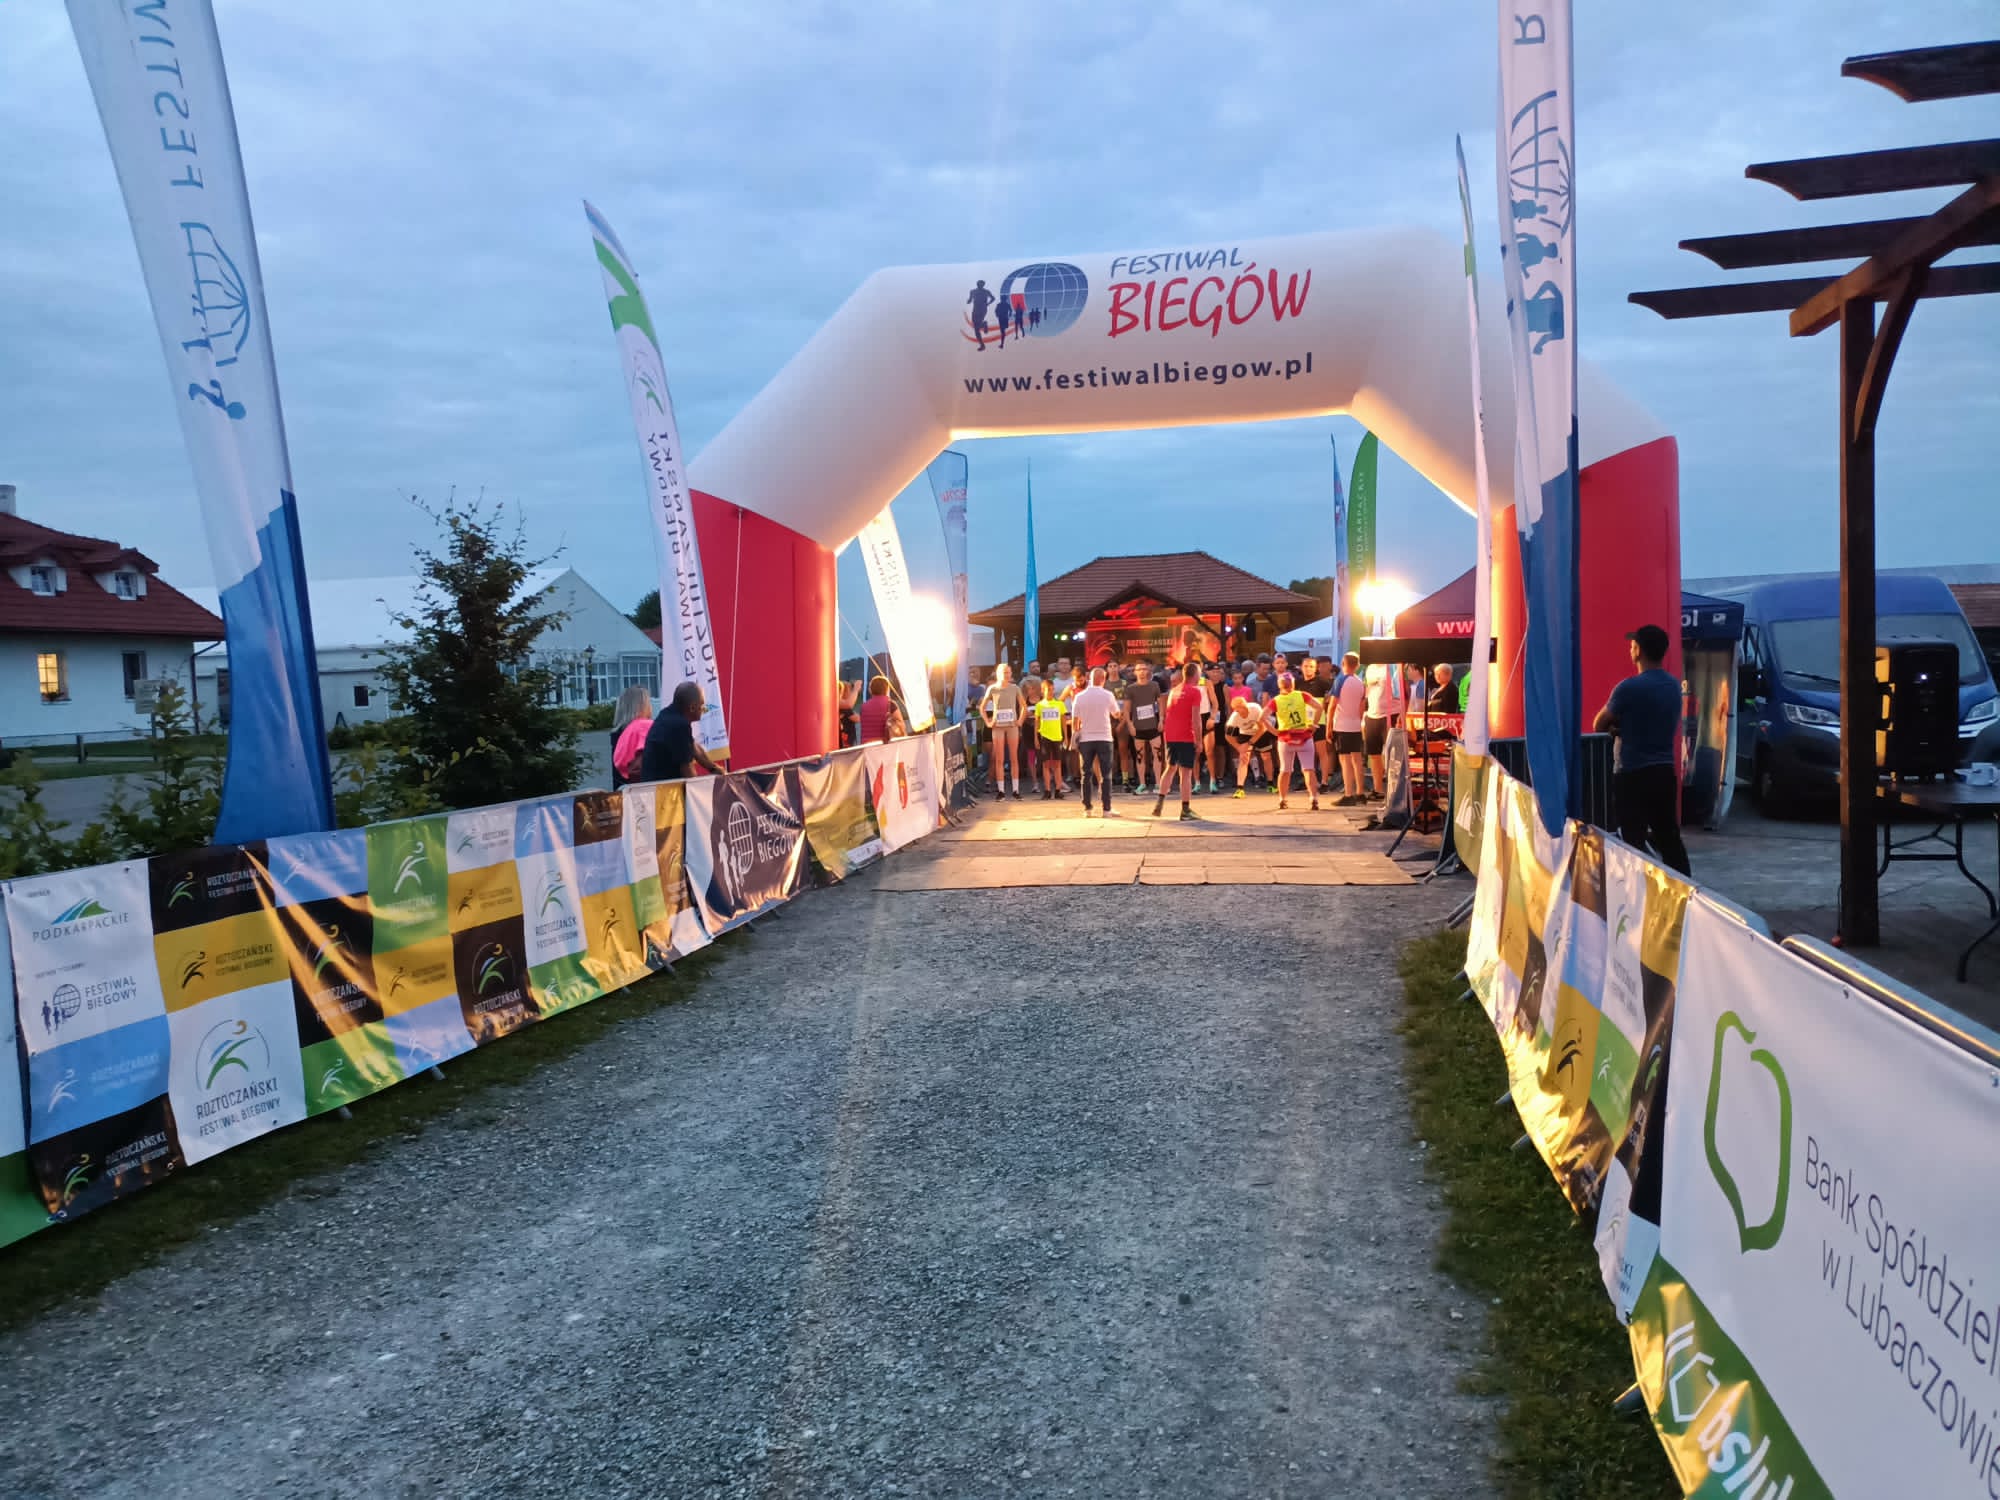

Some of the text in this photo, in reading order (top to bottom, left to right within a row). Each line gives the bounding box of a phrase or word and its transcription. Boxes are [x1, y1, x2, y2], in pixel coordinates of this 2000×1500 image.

[1110, 247, 1244, 278] FESTIWAL
[1107, 261, 1312, 339] BIEGÓW
[963, 351, 1313, 394] www.festiwalbiegow.pl
[84, 975, 137, 998] FESTIWAL
[86, 988, 138, 1011] BIEGOWY
[196, 1077, 279, 1120] ROZTOCZAŃSKI
[1805, 1135, 1860, 1234] Bank
